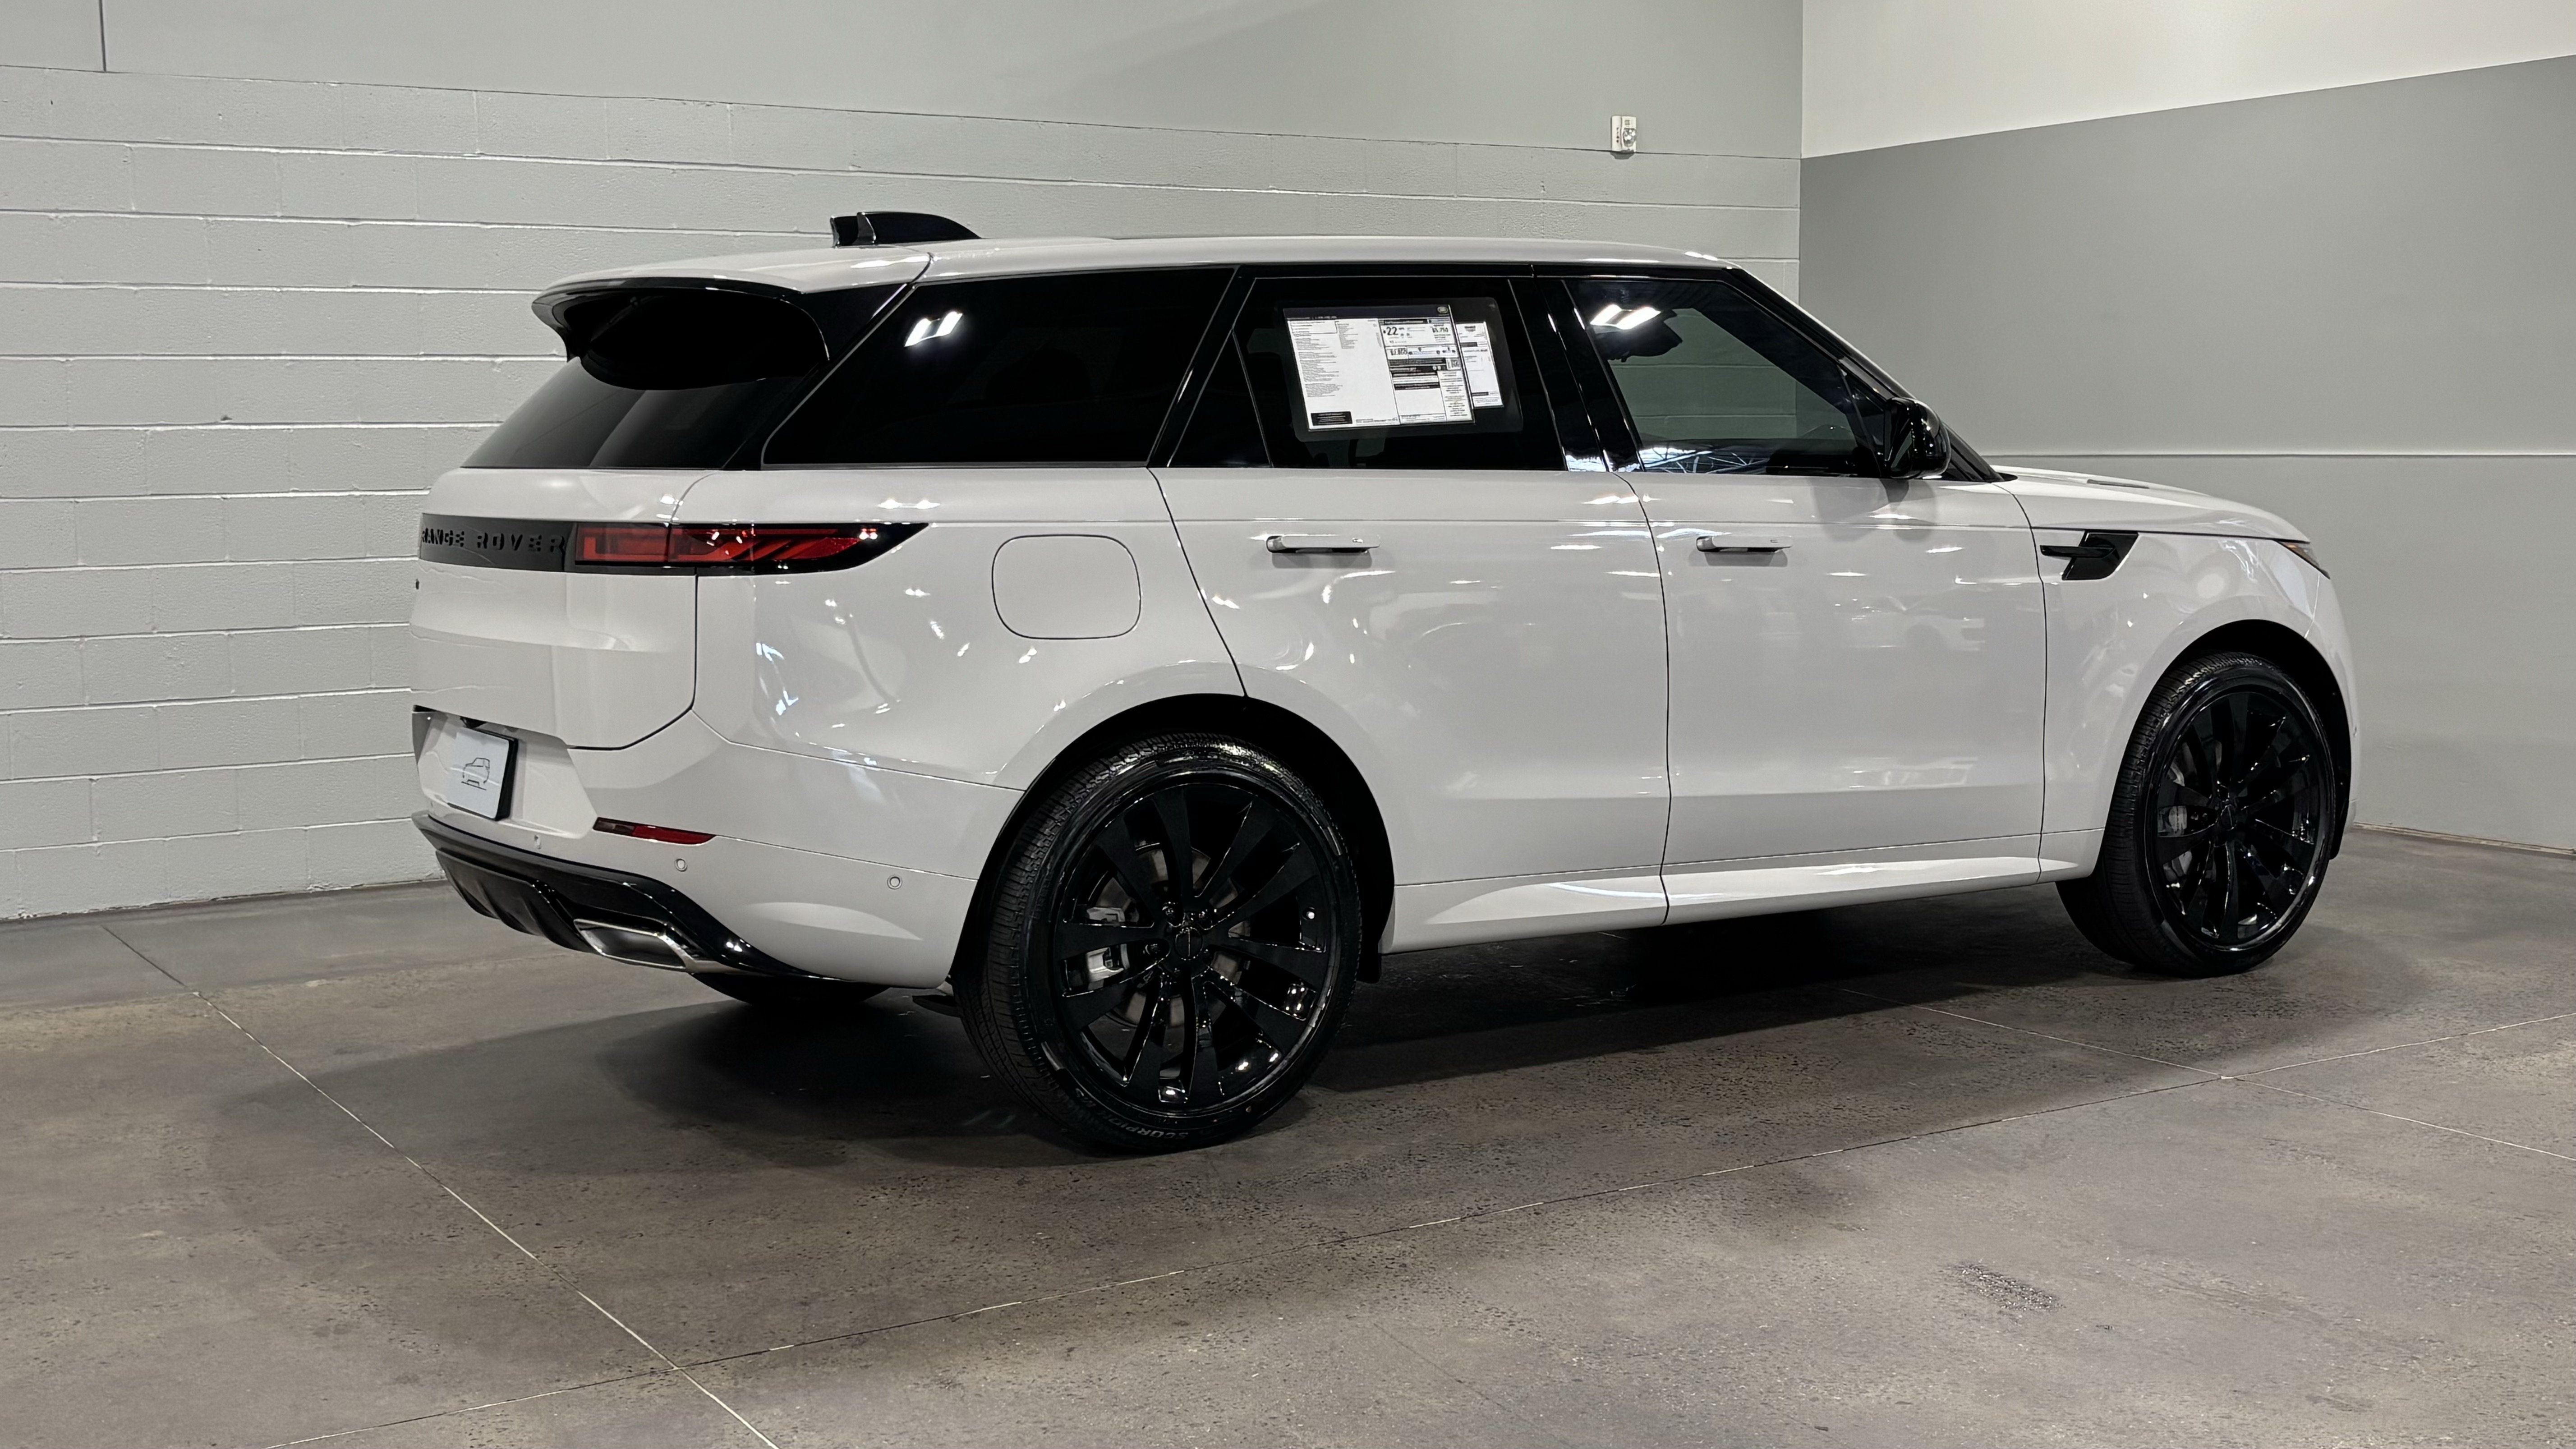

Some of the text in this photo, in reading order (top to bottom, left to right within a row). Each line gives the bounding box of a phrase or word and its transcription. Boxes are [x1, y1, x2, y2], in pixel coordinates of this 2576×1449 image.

[1386, 327, 1398, 335] 22
[422, 528, 566, 553] RANGE ROVER
